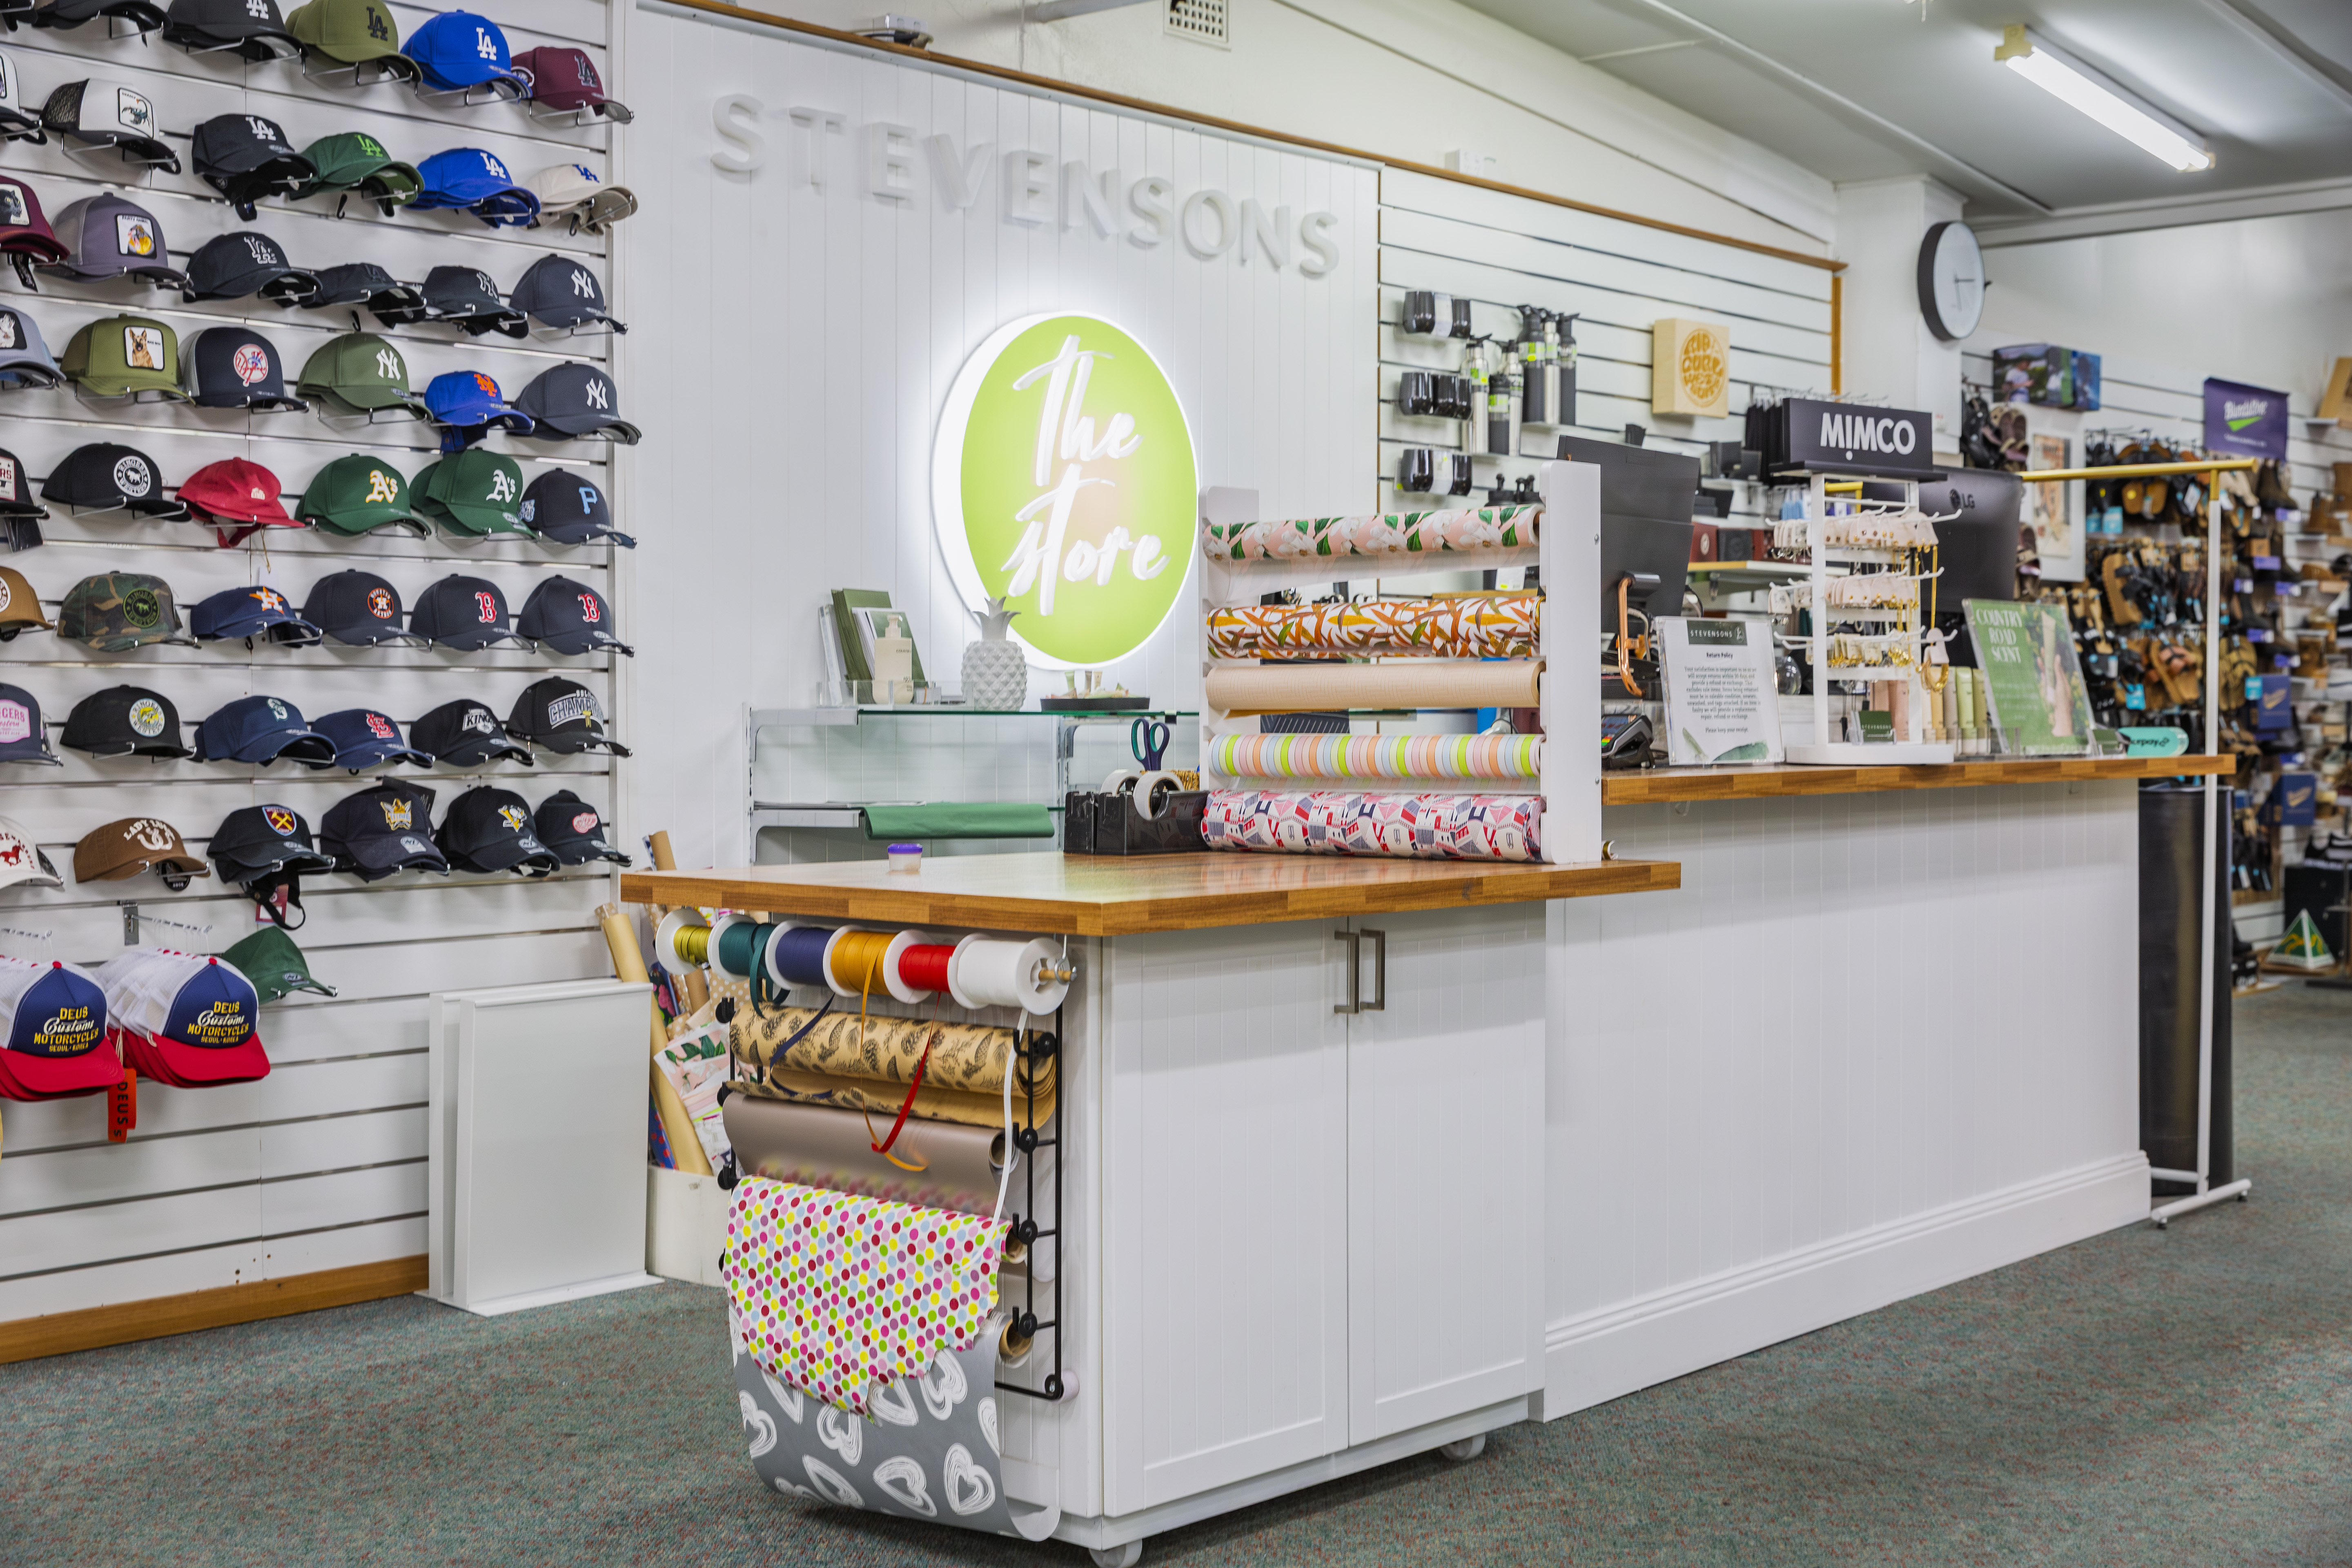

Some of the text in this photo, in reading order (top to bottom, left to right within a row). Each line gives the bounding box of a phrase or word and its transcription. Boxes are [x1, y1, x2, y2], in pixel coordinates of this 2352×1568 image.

[366, 6, 388, 41] LA
[476, 27, 497, 61] LA
[574, 54, 597, 87] LA
[245, 116, 276, 141] LA
[354, 135, 383, 157] LA
[480, 152, 506, 179] LA
[572, 164, 600, 183] LA
[710, 93, 1340, 279] STEVENSONS
[244, 236, 278, 264] LA
[571, 269, 595, 298] NY
[376, 348, 401, 381] NY
[586, 377, 608, 409] NY
[1013, 334, 1142, 486] The
[1820, 412, 1916, 455] MIMCO
[0, 468, 12, 479] RS
[365, 469, 399, 504] A's
[486, 469, 516, 503] A's
[579, 487, 598, 514] P
[1961, 494, 1975, 509] LG
[1001, 463, 1171, 616] store
[475, 592, 497, 623] B
[578, 593, 600, 622] B
[1976, 609, 2022, 627] COUNTRY
[1690, 629, 1732, 638] STEVENSONS
[1988, 627, 2016, 645] ROAD
[0, 708, 24, 722] GERS
[123, 820, 148, 840] LADY
[60, 1006, 88, 1020] DEUS
[198, 1010, 245, 1027] Customs
[214, 1001, 239, 1013] DEUS
[34, 1027, 98, 1045] MOTORCYCLES
[44, 1017, 94, 1035] Customs
[187, 1023, 249, 1037] MOTORCYCLES
[117, 1082, 128, 1125] DEUS
